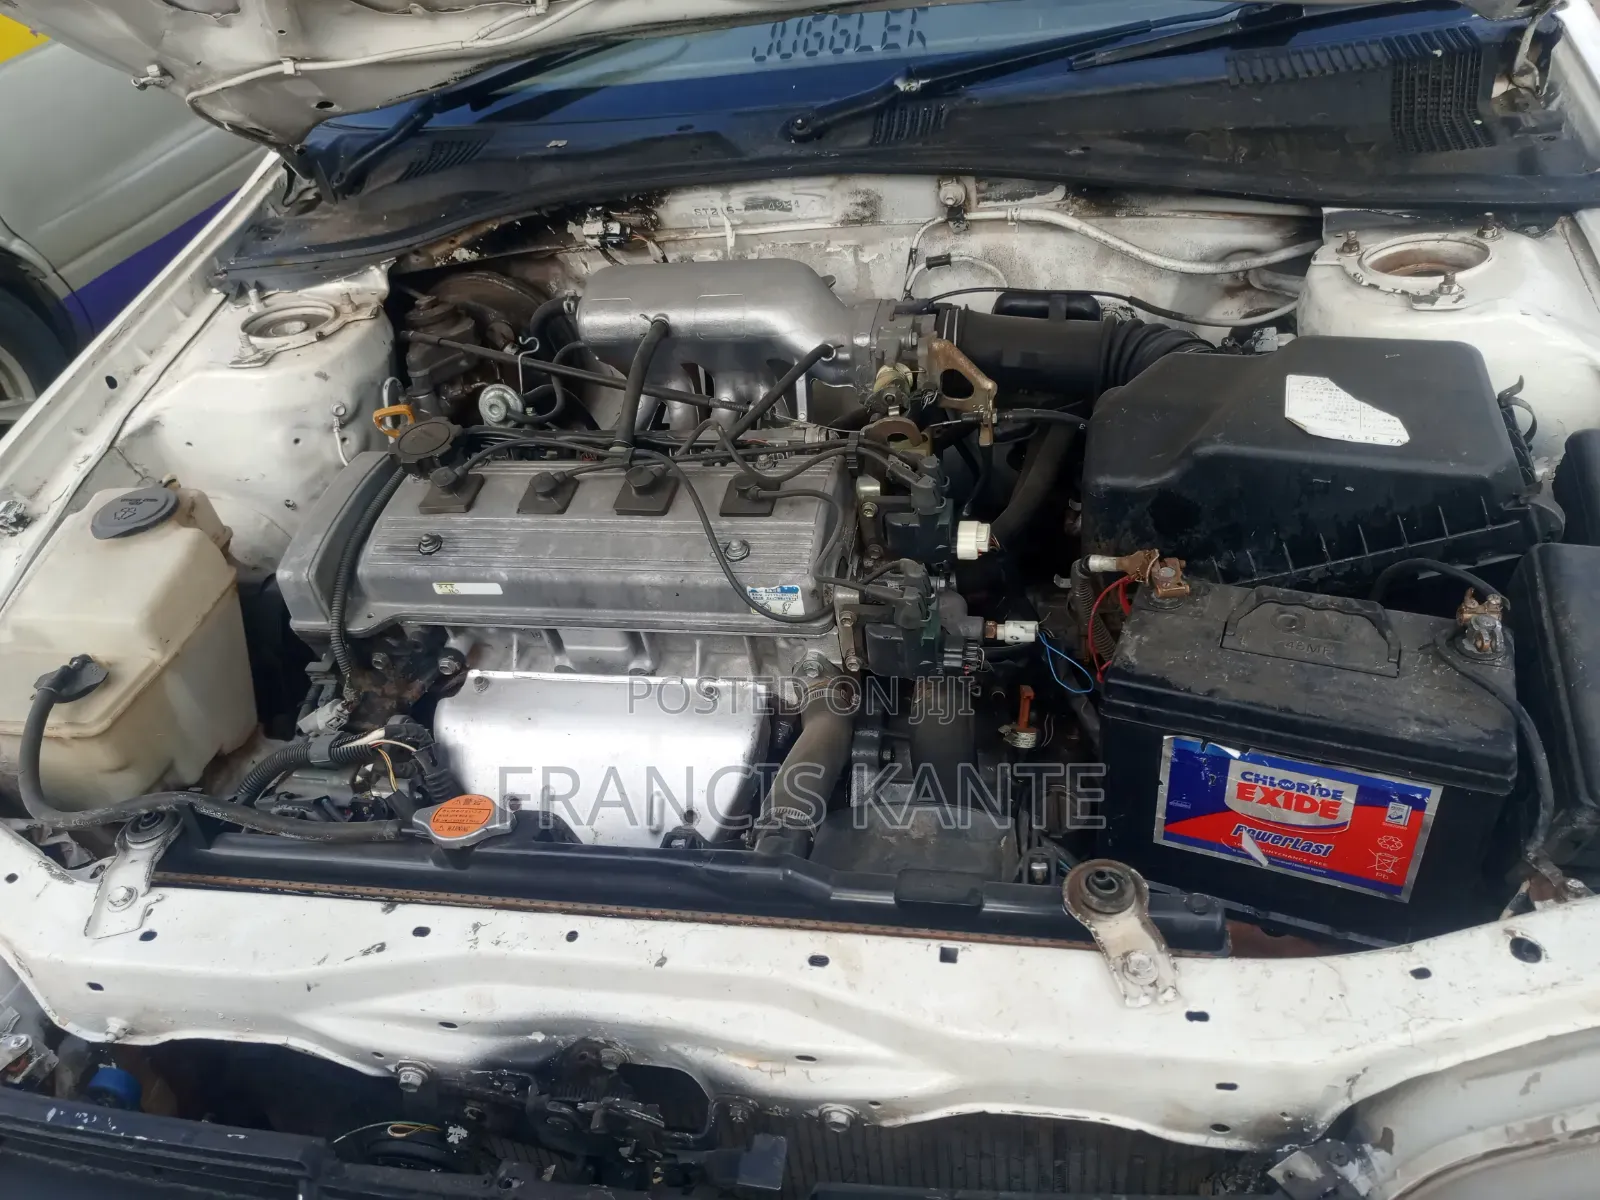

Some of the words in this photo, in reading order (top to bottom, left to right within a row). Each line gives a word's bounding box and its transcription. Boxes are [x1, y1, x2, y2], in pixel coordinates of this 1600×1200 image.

[1235, 781, 1342, 820] EXIDE
[1240, 771, 1345, 801] CHLORIDE
[1262, 848, 1307, 862] AINTENANCE
